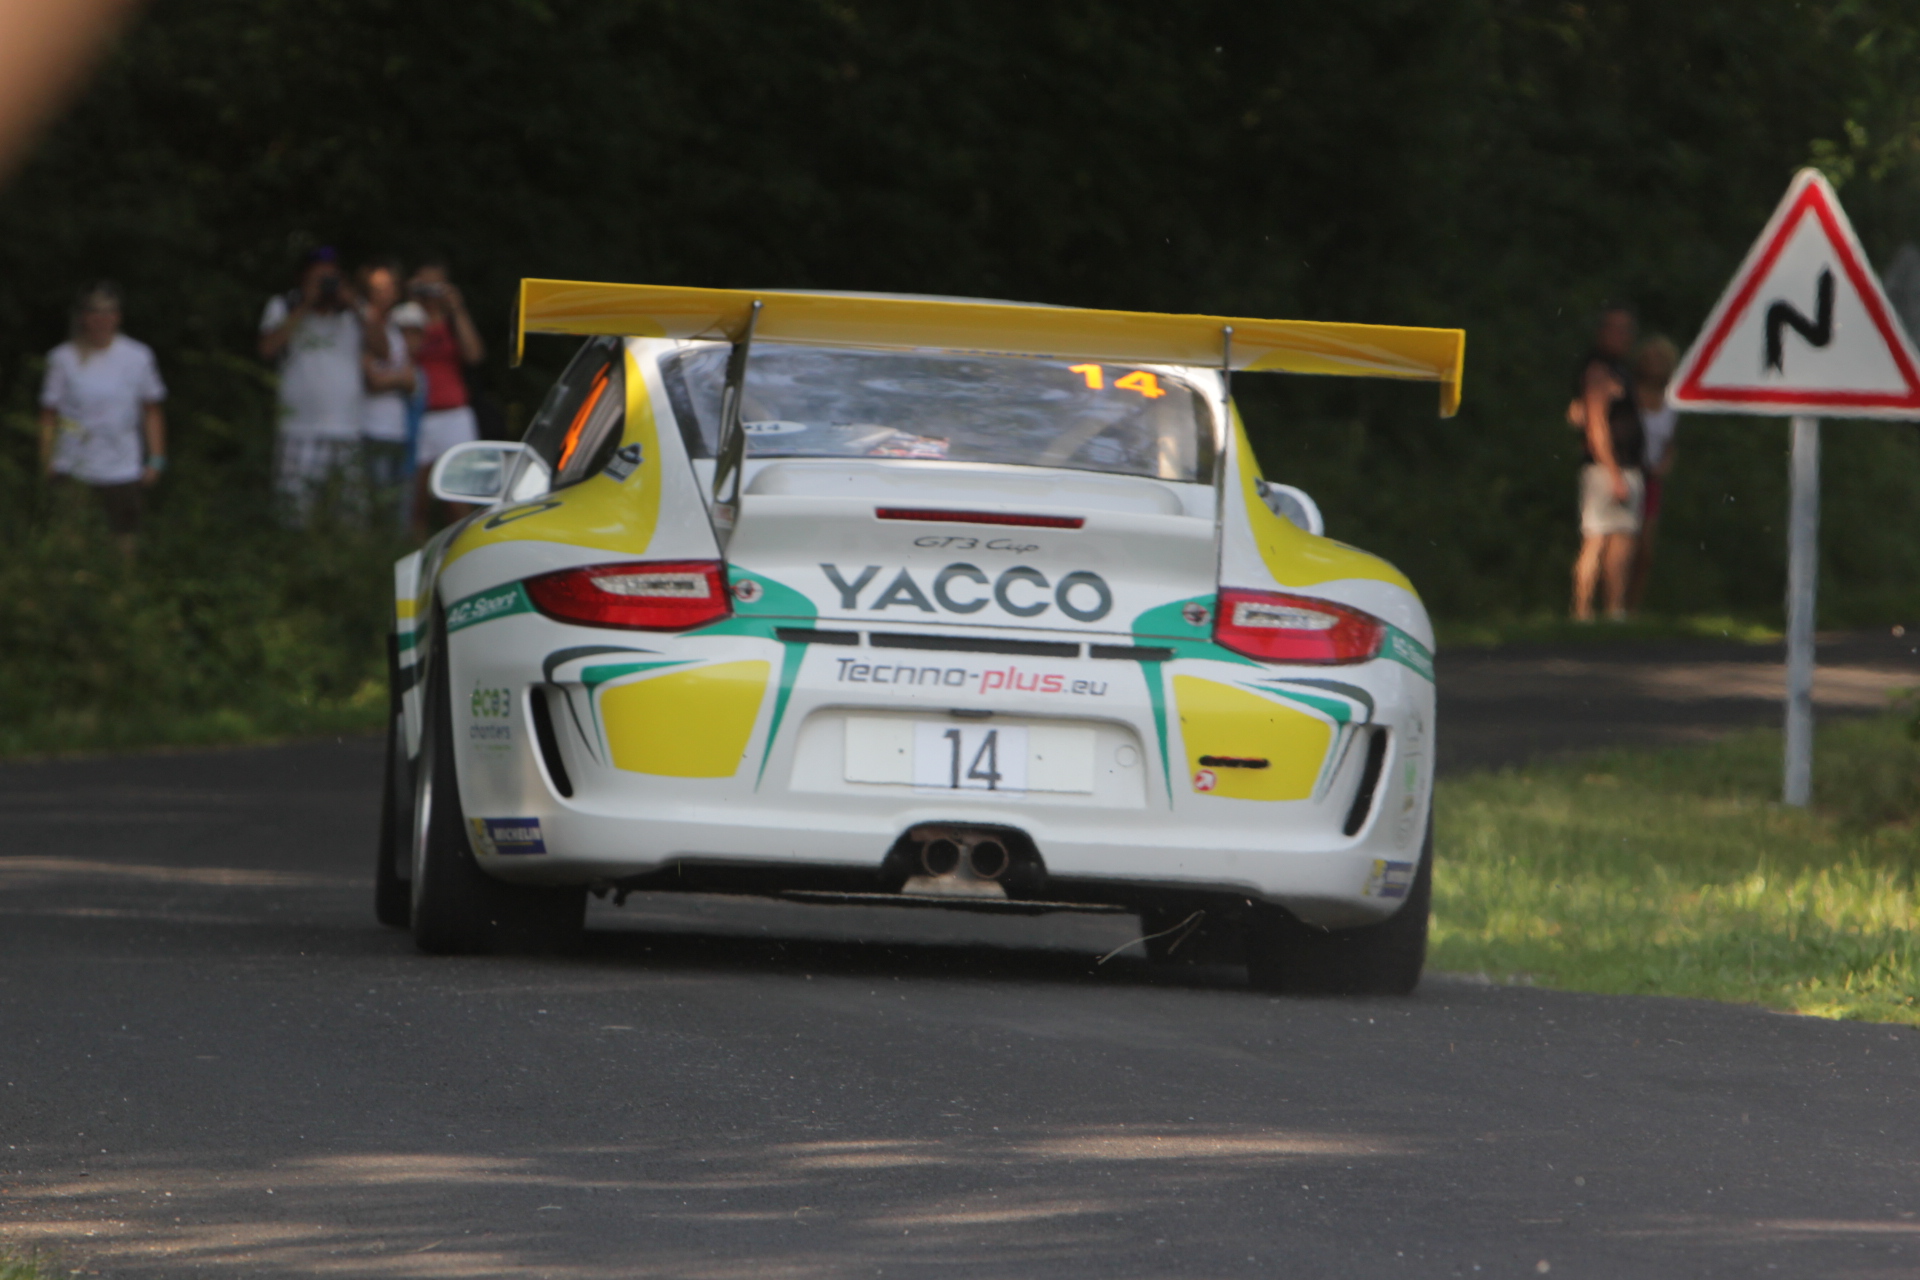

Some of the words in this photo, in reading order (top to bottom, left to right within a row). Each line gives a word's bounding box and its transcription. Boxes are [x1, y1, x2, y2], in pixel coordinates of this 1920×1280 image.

[1067, 363, 1167, 398] 14
[913, 535, 979, 549] GT3
[986, 538, 1039, 555] Cup
[819, 561, 1114, 623] YACCO
[836, 657, 1108, 697] Techno-plus.eu
[944, 729, 1003, 790] 14
